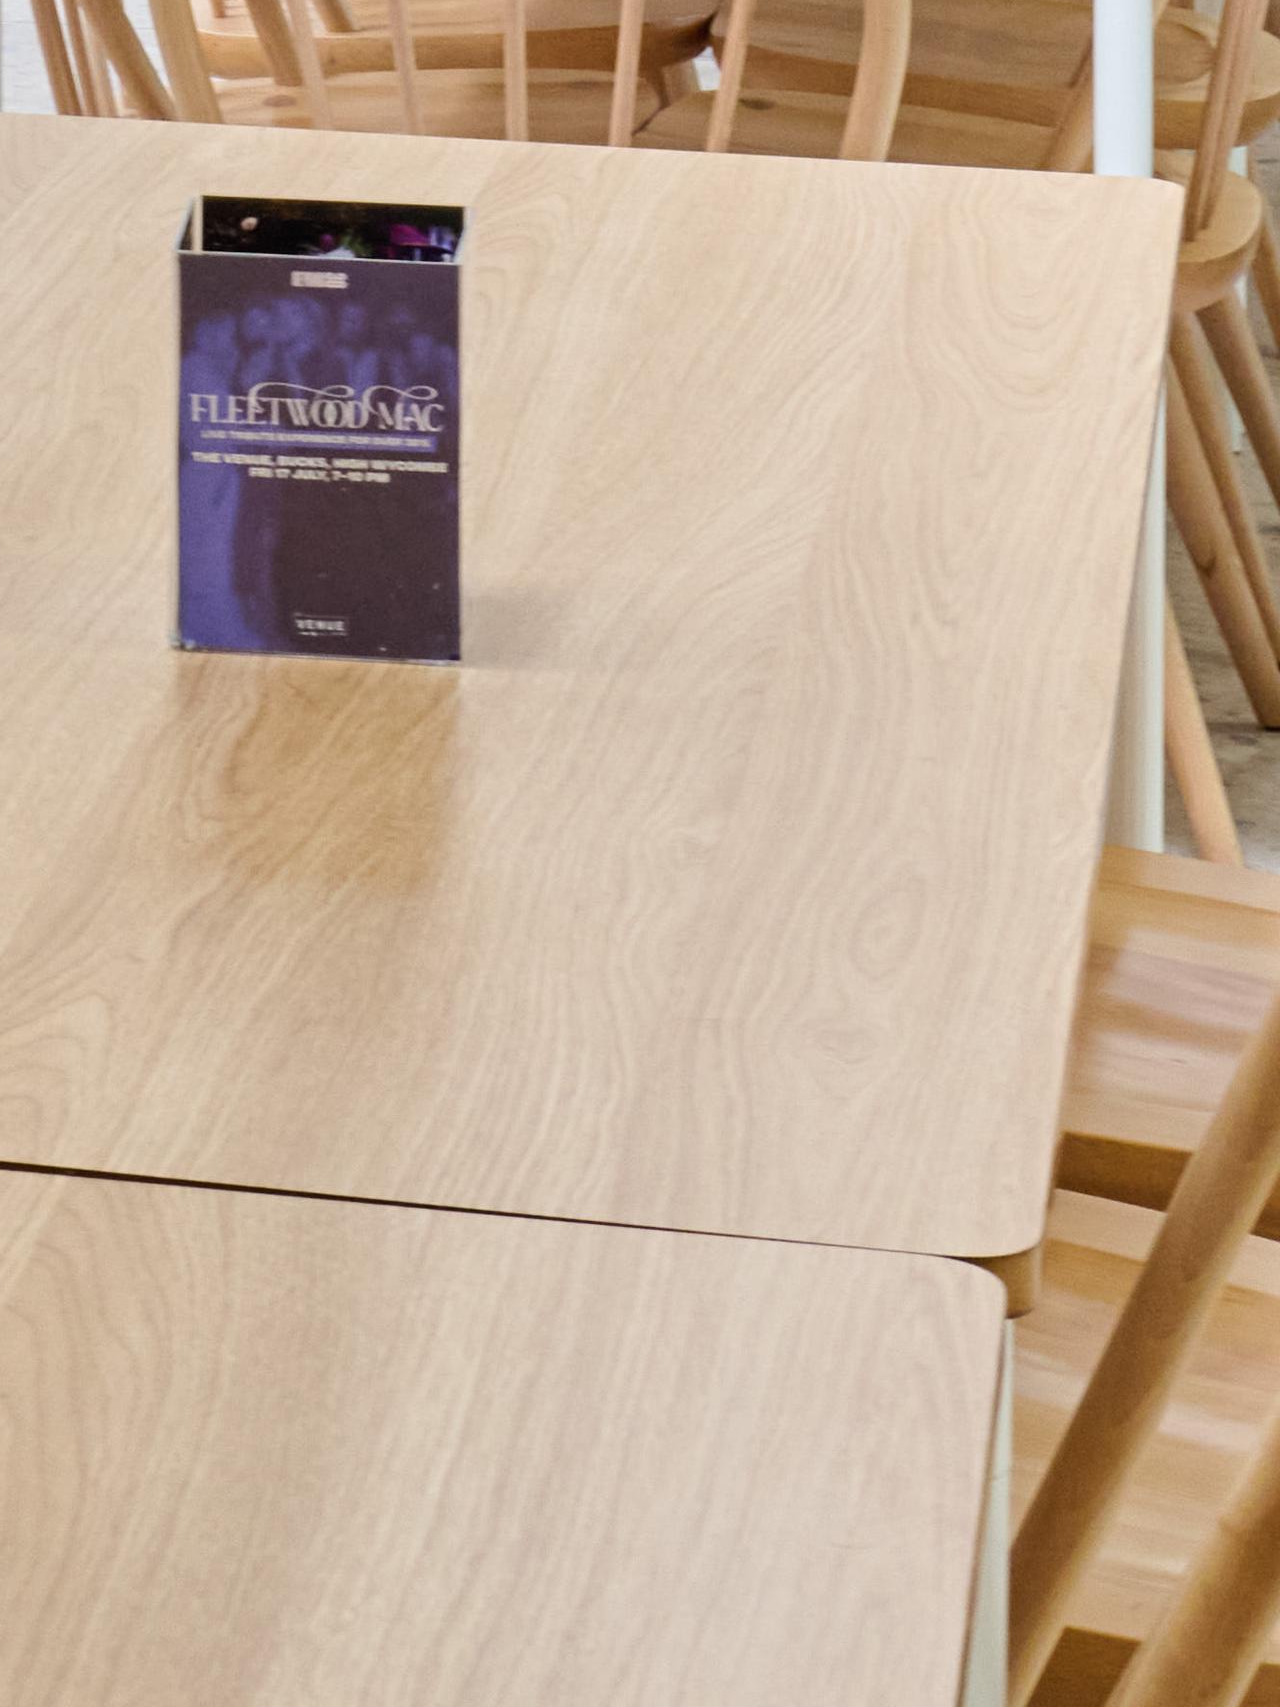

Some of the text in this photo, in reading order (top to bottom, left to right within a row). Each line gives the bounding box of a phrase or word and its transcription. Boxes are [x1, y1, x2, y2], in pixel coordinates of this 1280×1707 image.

[188, 382, 444, 432] FLEETWOOD MAC
[295, 619, 344, 631] VENUE
